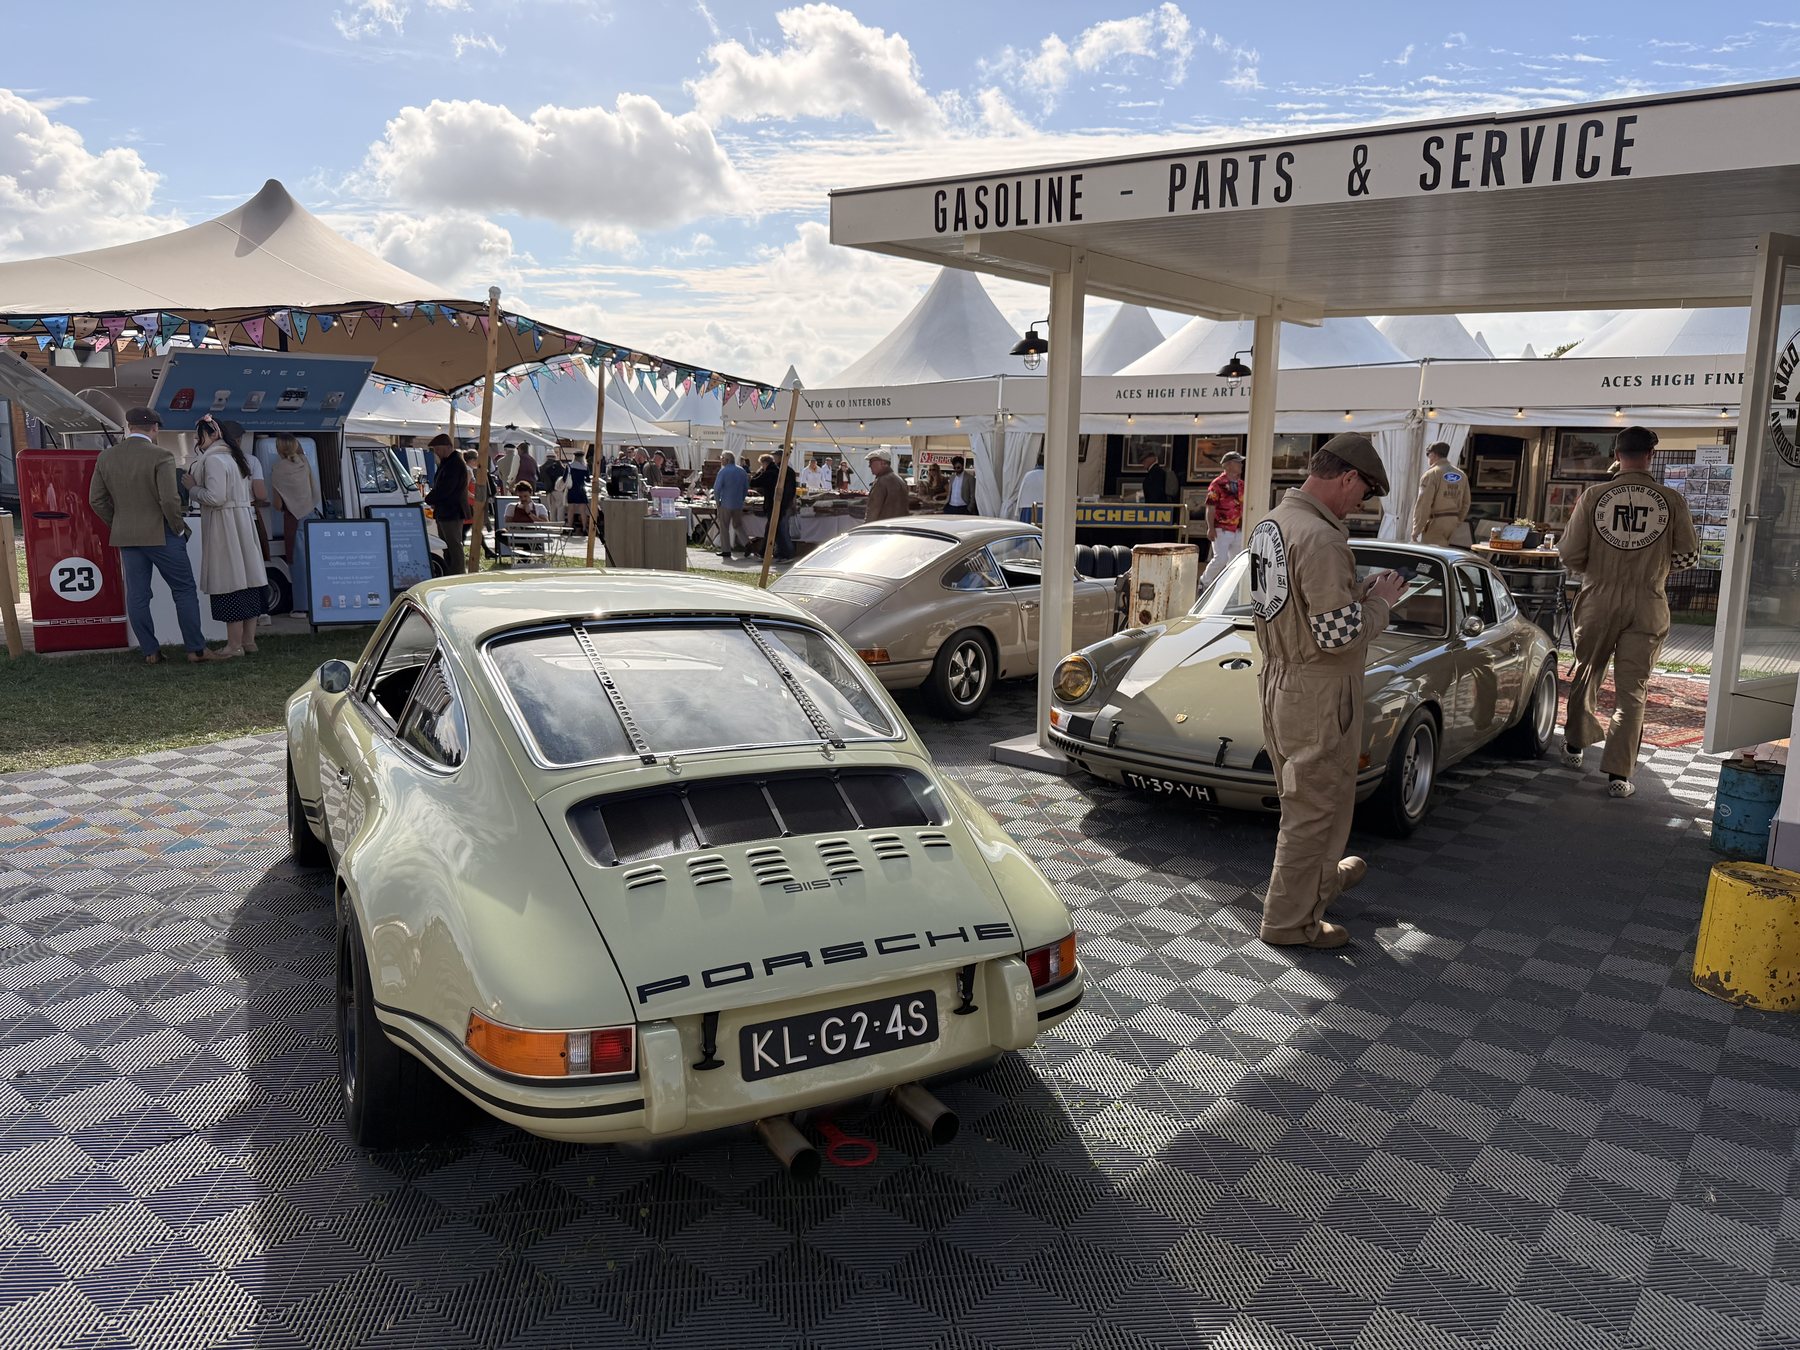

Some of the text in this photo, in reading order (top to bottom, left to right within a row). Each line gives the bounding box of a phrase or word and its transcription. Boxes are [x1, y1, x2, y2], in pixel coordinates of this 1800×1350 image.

[934, 173, 1084, 235] GASOLINE
[1168, 152, 1294, 213] PARTS
[1348, 144, 1371, 197] &
[1419, 114, 1638, 192] SERVICE
[243, 368, 306, 377] SMEG
[1601, 375, 1643, 388] ACES
[1651, 373, 1696, 387] HIGH
[1772, 342, 1799, 401] RICO
[836, 399, 846, 408] CO
[849, 397, 892, 408] INTERIORS
[1116, 389, 1142, 399] ACES
[1147, 388, 1175, 399] HIGH
[1181, 387, 1207, 398] FINE
[1212, 386, 1235, 397] ART
[1771, 411, 1800, 466] AIRCOOLE
[1646, 489, 1667, 511] GARAGE
[1599, 525, 1630, 548] AIRCOOLED
[58, 566, 95, 593] 23
[50, 616, 110, 626] PORSCHE
[635, 921, 1015, 1005] PORSCHE
